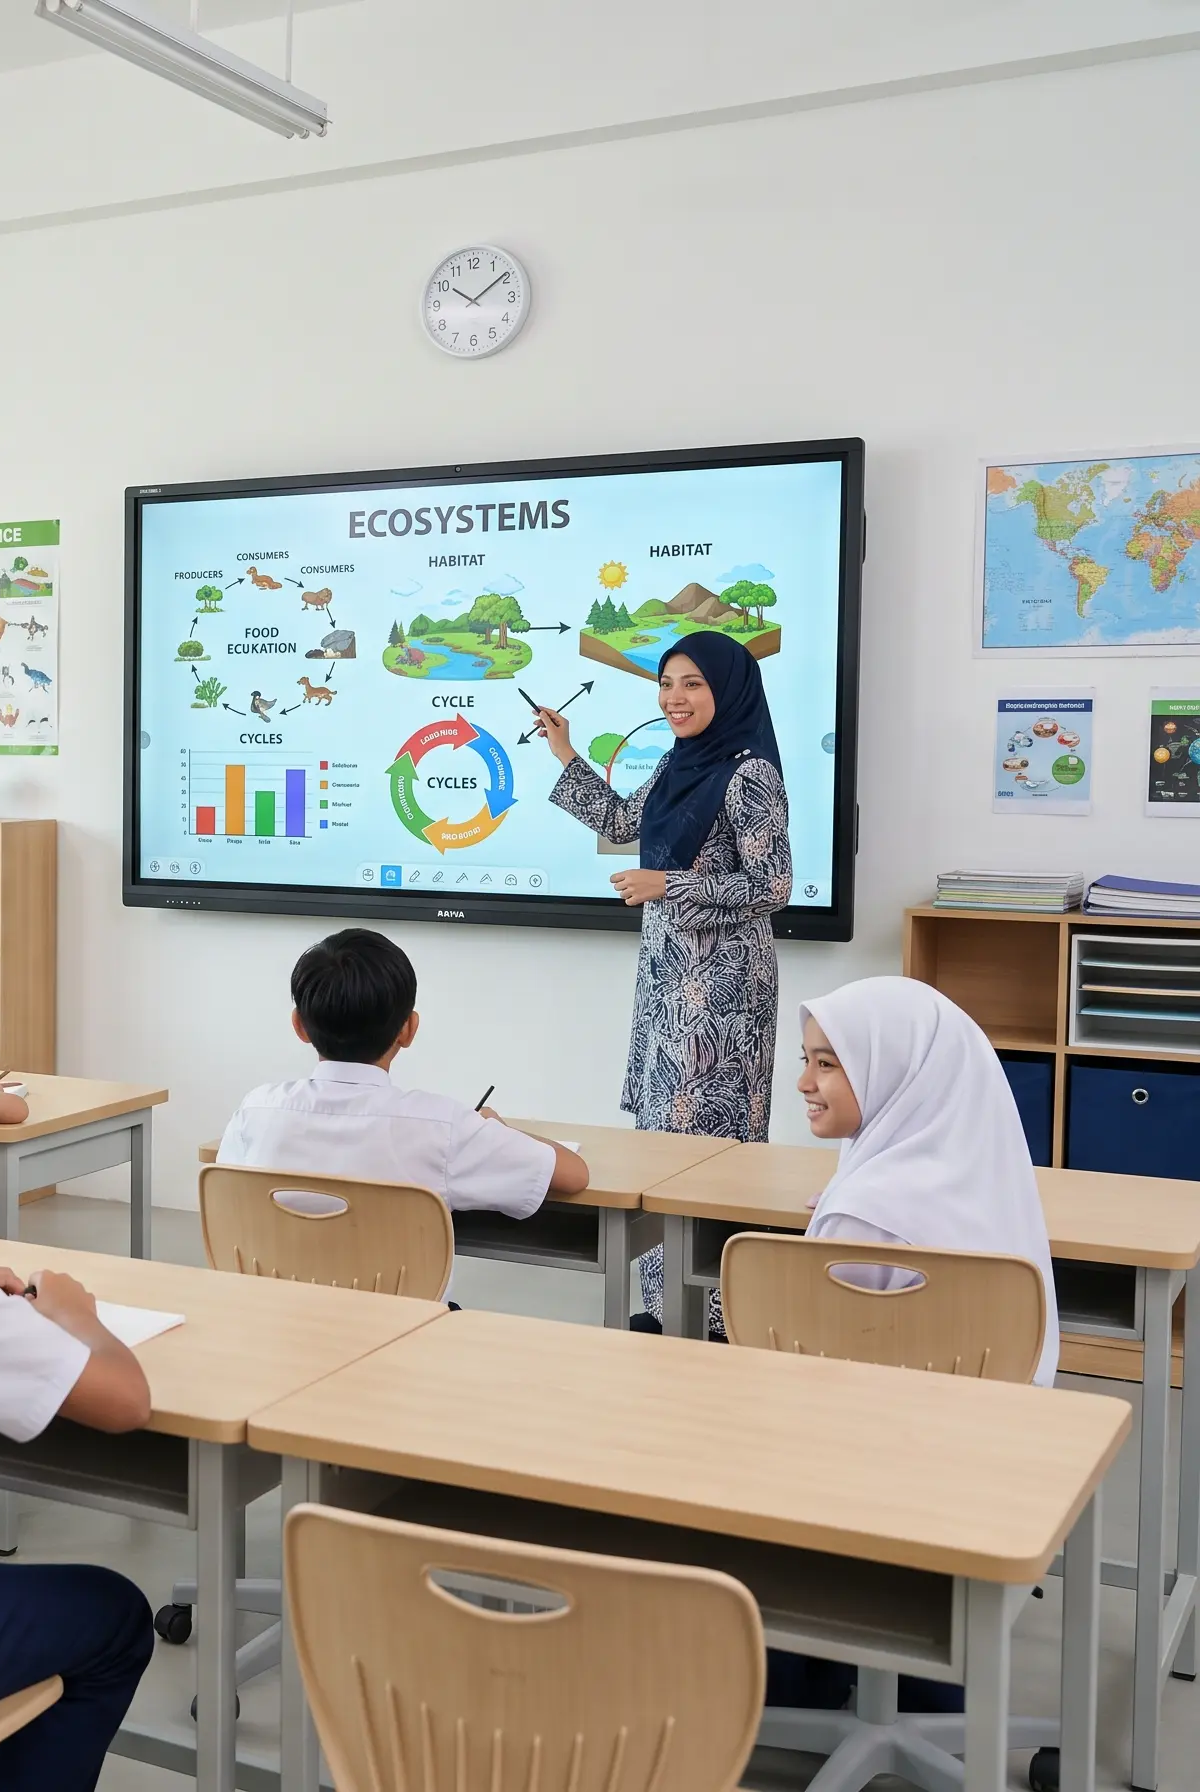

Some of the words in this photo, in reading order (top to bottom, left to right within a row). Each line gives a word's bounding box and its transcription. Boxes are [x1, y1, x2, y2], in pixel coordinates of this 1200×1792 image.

[467, 257, 480, 270] 12
[490, 260, 495, 272] 1
[451, 266, 461, 277] 11
[502, 272, 510, 284] 2
[437, 280, 449, 292] 10
[508, 291, 516, 303] 3
[433, 300, 440, 312] 9
[502, 312, 509, 323] 4
[438, 319, 446, 330] 8
[452, 332, 459, 343] 7
[488, 327, 496, 339] 5
[470, 335, 478, 346] 6
[349, 499, 570, 539] ECOSYSTEMS
[237, 551, 289, 561] CONSUMERS
[649, 543, 713, 558] HABITAT
[428, 554, 485, 568] HABITAT
[301, 565, 355, 574] CONSUMERS
[245, 627, 279, 638] FOOD
[228, 643, 297, 654] ECUKATION
[432, 696, 474, 708] CYCLE
[240, 733, 283, 744] CYCLES
[427, 777, 477, 789] CYCLES
